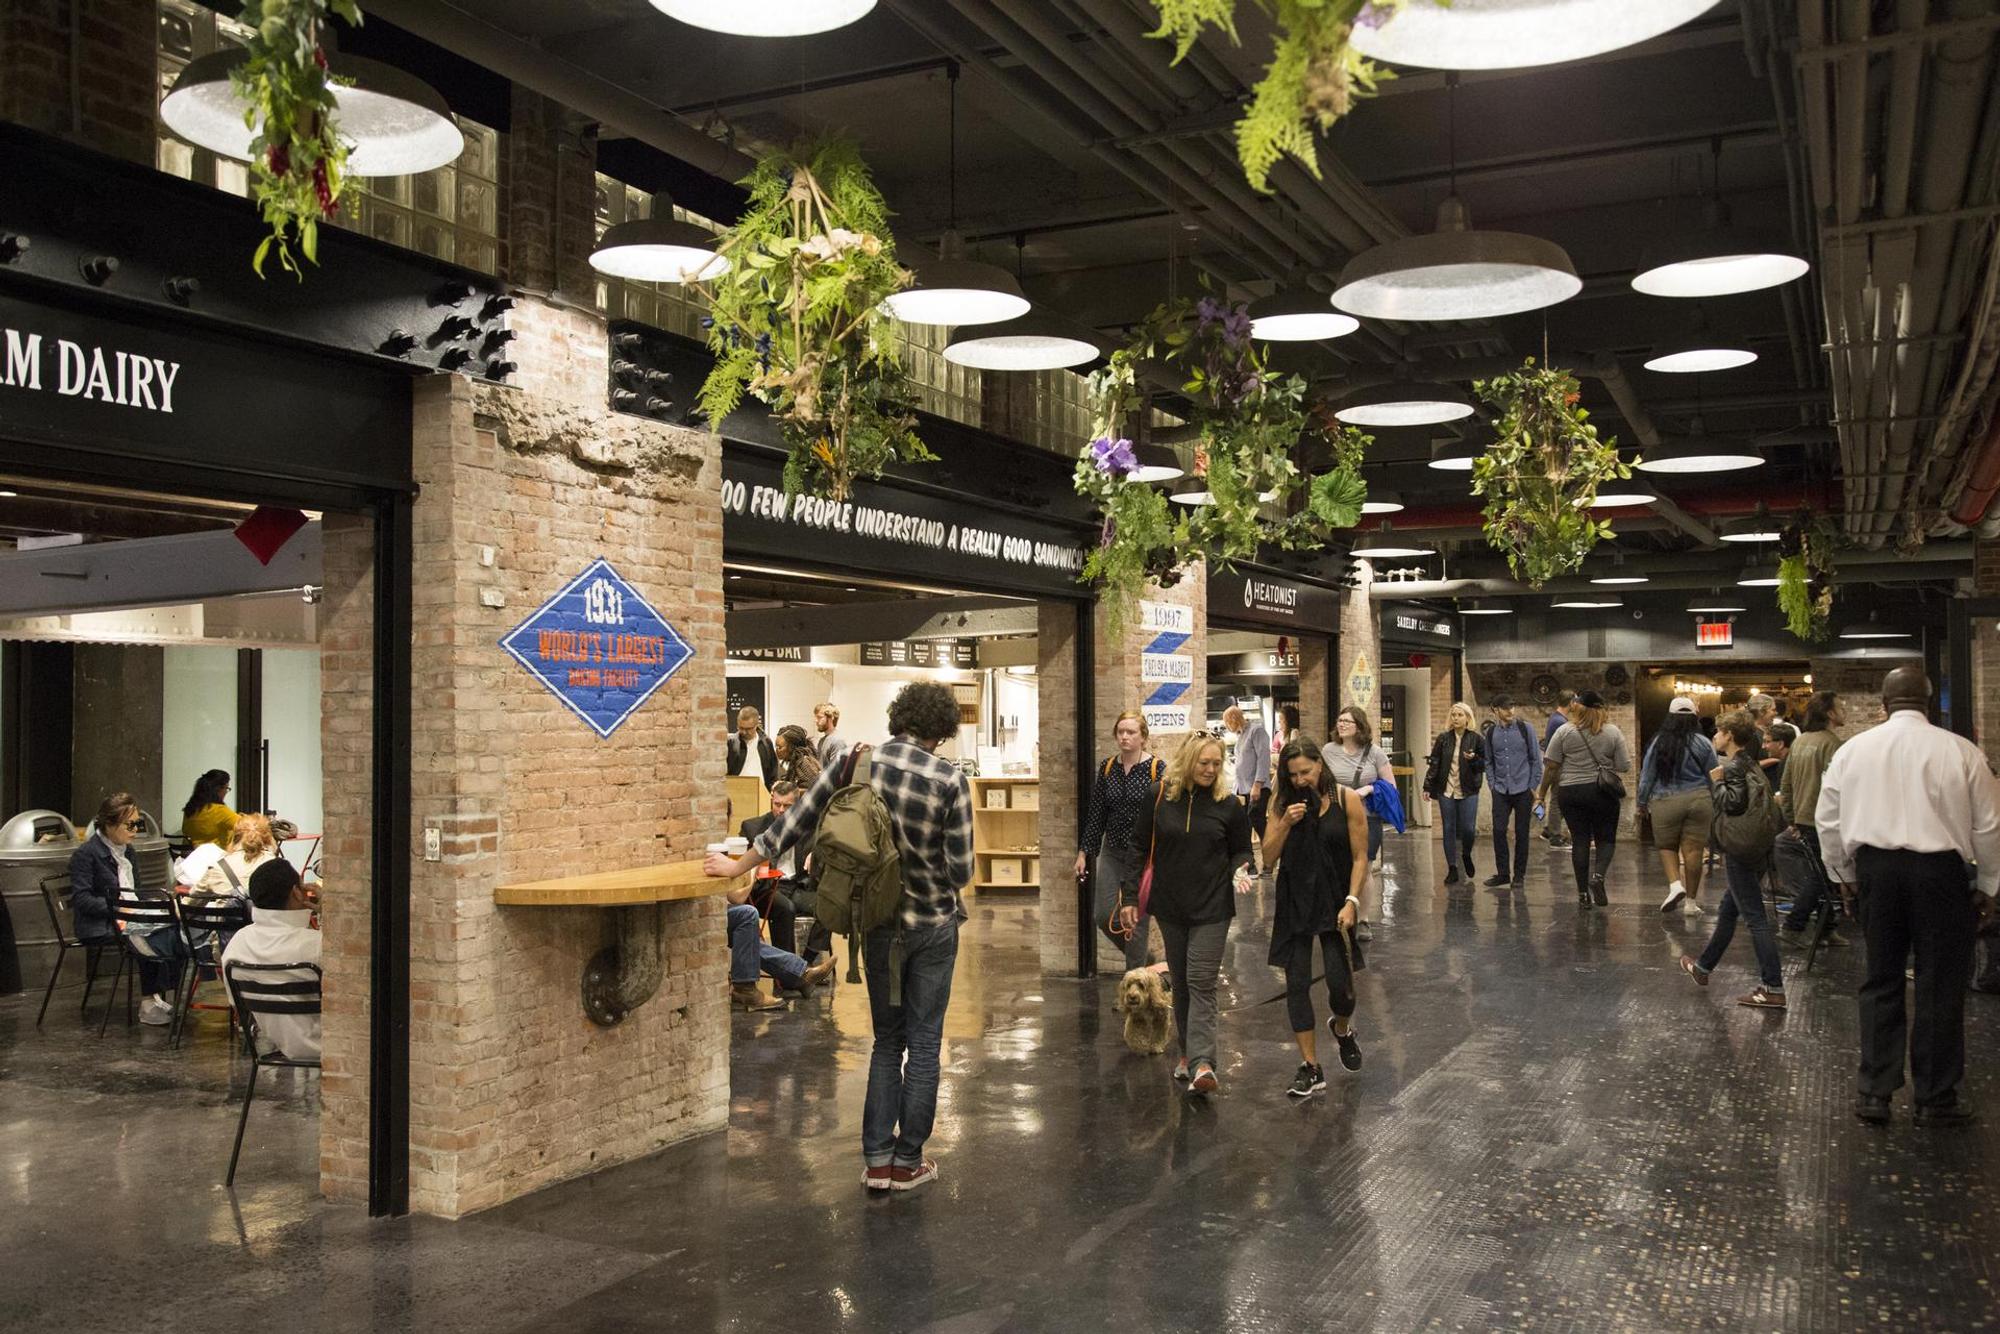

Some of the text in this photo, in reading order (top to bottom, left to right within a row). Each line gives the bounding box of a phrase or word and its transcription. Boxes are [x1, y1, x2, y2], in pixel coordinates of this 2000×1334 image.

[0, 328, 180, 413] M DAIRY
[721, 480, 748, 513] OO
[751, 485, 790, 521] FEW
[793, 493, 853, 533] PEOPLE
[855, 506, 945, 548] UNDERSTAND
[947, 524, 959, 552] A
[960, 527, 1002, 559] REALLY
[1003, 535, 1032, 563] GOOD
[583, 578, 625, 625] 1931
[1253, 581, 1297, 607] HEATONIST
[1154, 606, 1182, 629] 1997
[538, 630, 665, 665] WORLD'S LARGEST
[1169, 660, 1190, 679] MARKET
[1147, 713, 1185, 727] OPENS
